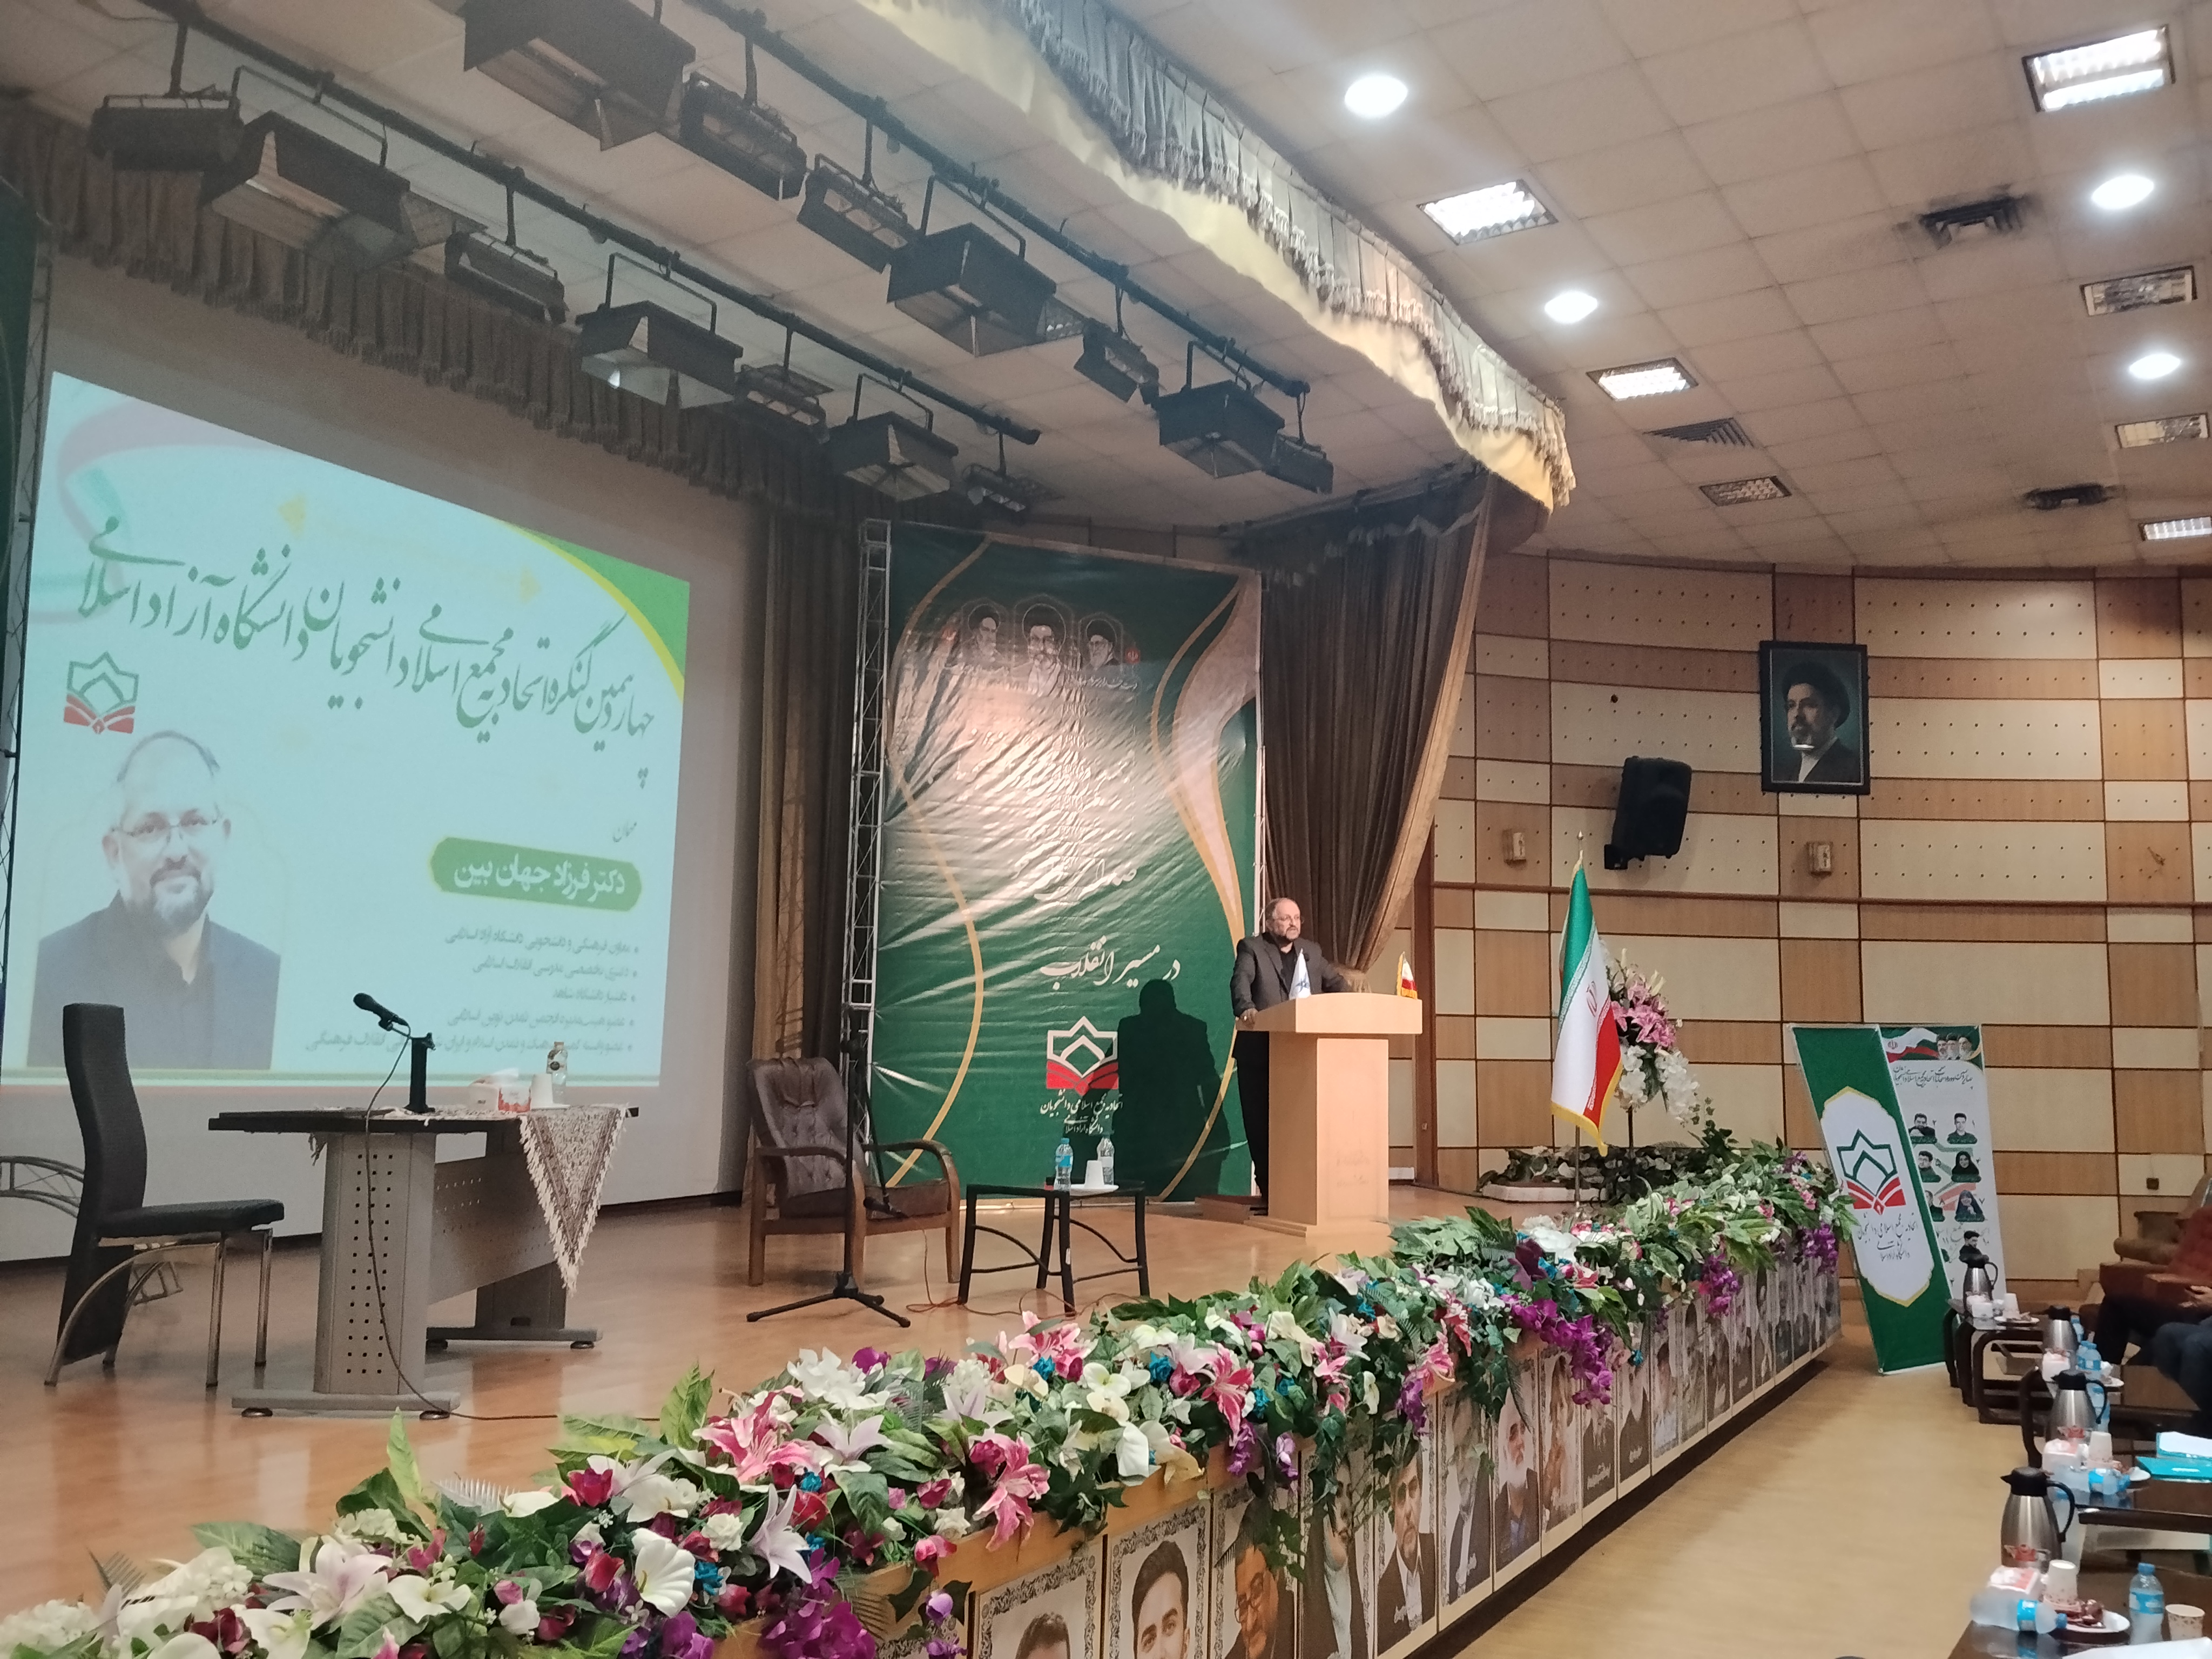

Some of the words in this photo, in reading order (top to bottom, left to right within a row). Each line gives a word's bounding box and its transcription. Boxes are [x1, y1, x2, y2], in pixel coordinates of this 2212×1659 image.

[78, 516, 186, 624] اسلامی
[141, 565, 237, 642] آزاد
[213, 543, 309, 663] دانشگاه
[303, 576, 409, 710] دانشجویان
[412, 603, 489, 698] اسلامی
[456, 627, 514, 729] مجمع
[545, 611, 628, 716] کنگره
[454, 860, 493, 888] بین
[495, 853, 551, 892] جهان
[554, 859, 590, 900] فرزاد
[587, 868, 625, 903] دکتر
[445, 926, 479, 945] اسلامی
[479, 925, 492, 945] آزاد
[494, 929, 524, 945] دانشگاه
[525, 936, 566, 951] دانشجویی
[572, 938, 608, 956] فرهنگی
[472, 954, 505, 973] اسلامی
[1040, 935, 1115, 990] انقلاب
[1112, 944, 1161, 988] مسیر
[1162, 959, 1181, 981] در
[1040, 1088, 1071, 1118] دانشجویان
[1070, 1098, 1093, 1115] اسلامی
[1104, 1093, 1123, 1120] اتحادیه
